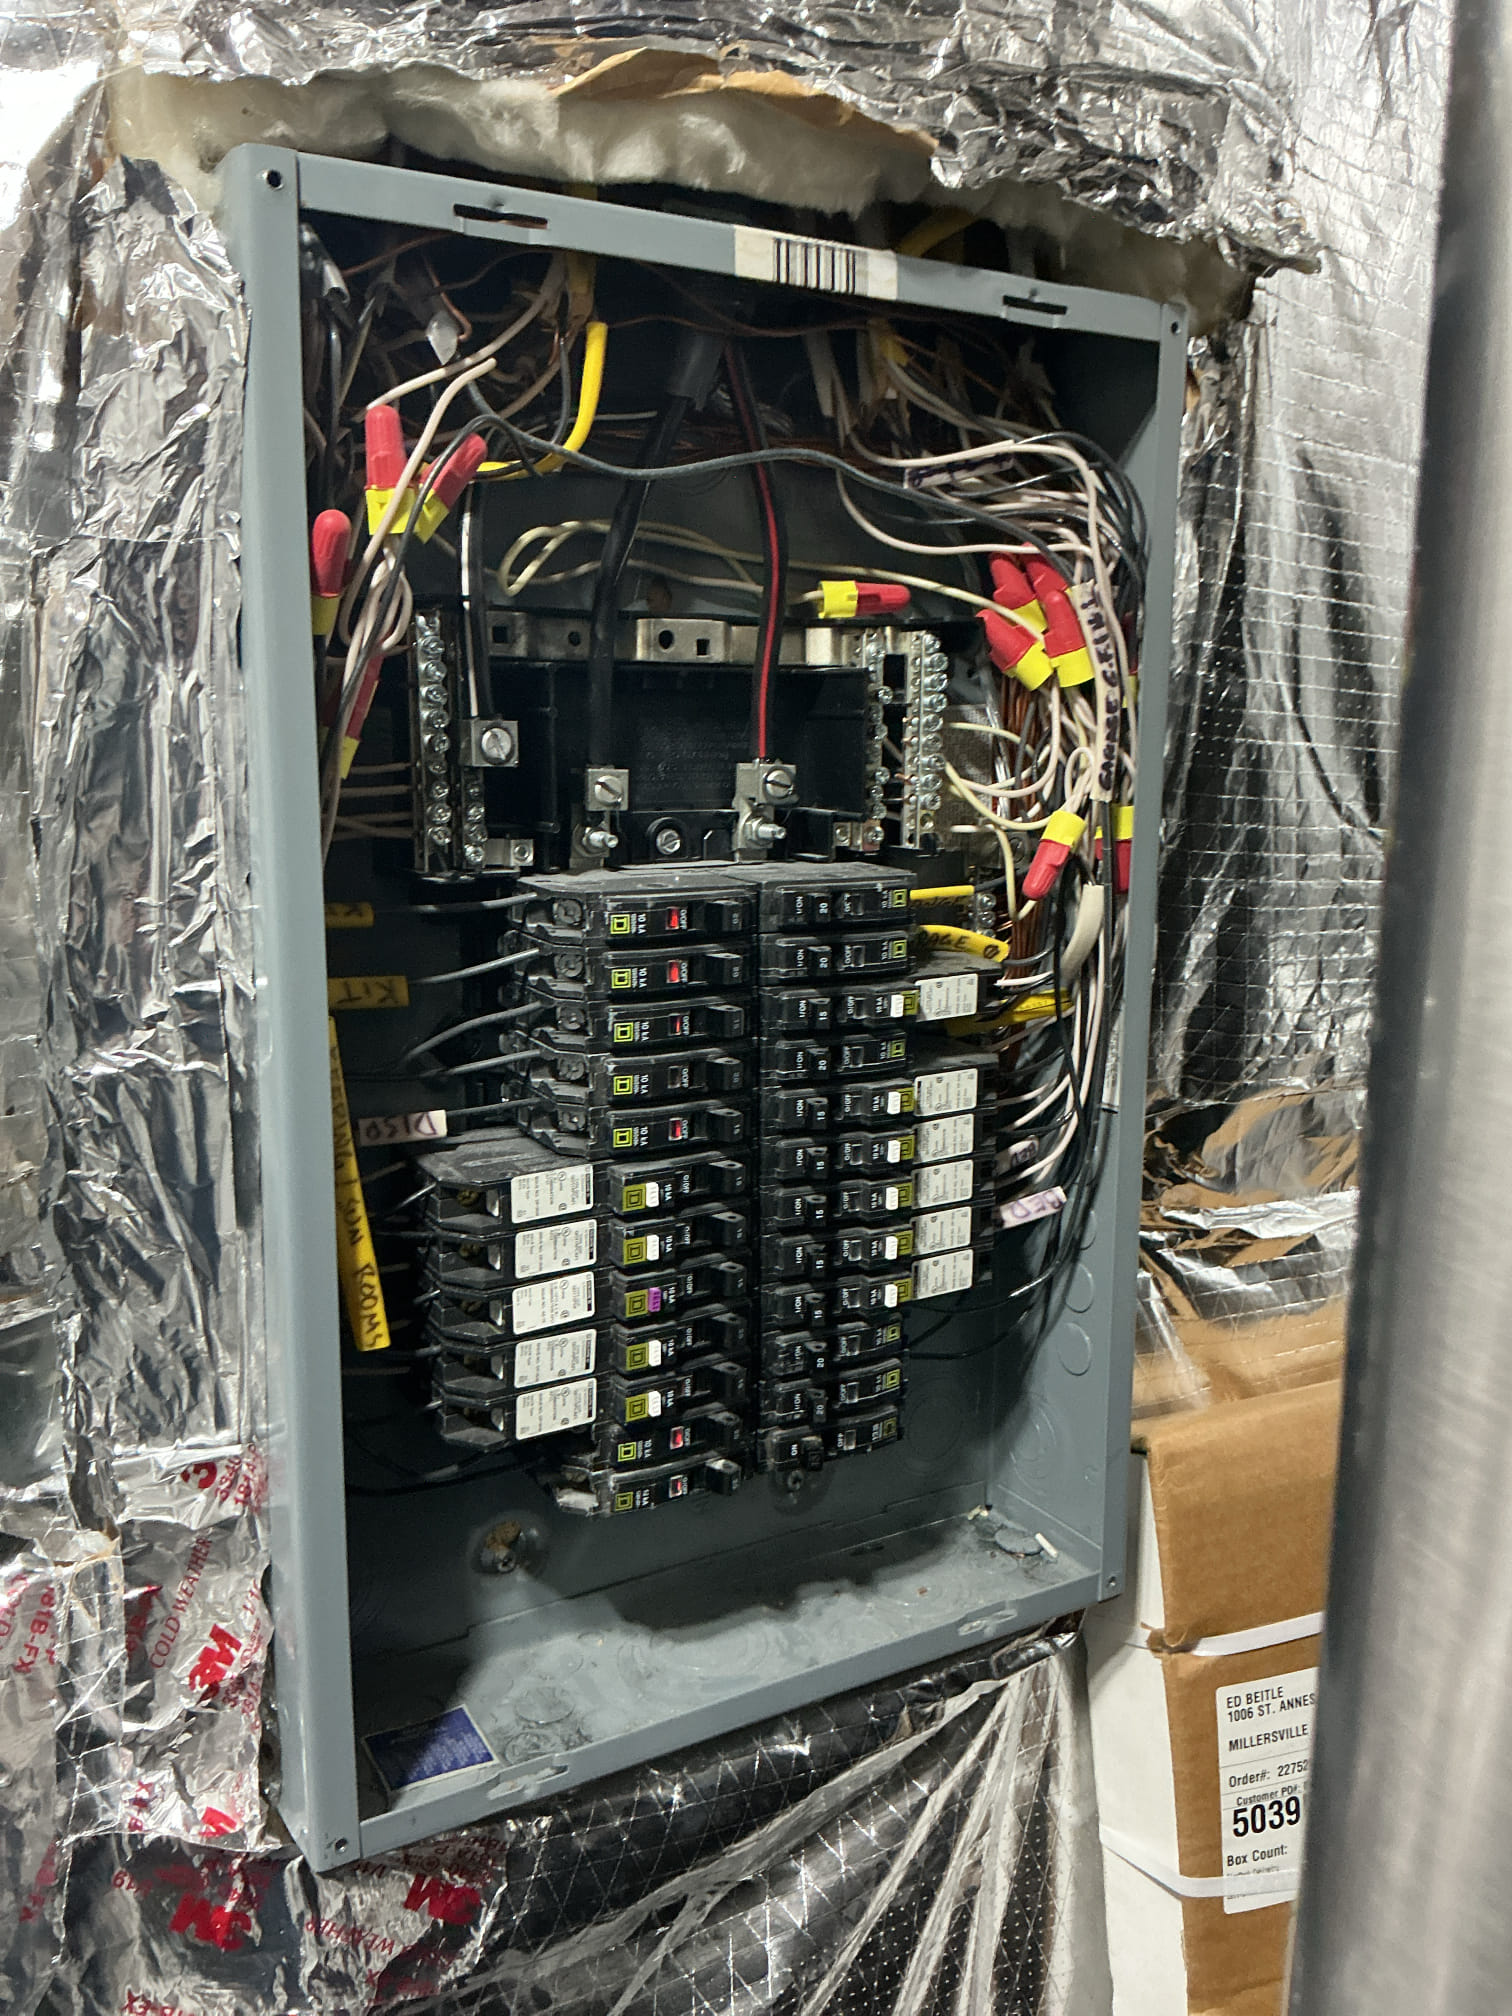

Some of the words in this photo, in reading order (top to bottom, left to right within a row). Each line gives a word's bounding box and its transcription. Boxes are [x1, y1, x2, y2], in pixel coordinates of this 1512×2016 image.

[638, 914, 646, 923] 10
[819, 958, 828, 968] 20
[639, 968, 647, 977] 10
[641, 1022, 649, 1030] 10
[819, 1060, 826, 1071] 20
[641, 1075, 648, 1083] 10
[817, 1112, 825, 1120] 15
[640, 1127, 648, 1135] 10
[816, 1210, 823, 1218] 15
[816, 1260, 823, 1269] 15
[355, 1262, 384, 1349] ROOMS
[817, 1358, 824, 1367] 20
[816, 1405, 823, 1415] 20
[150, 1616, 180, 1669] COLD
[172, 1536, 213, 1613] WEATHER
[188, 1623, 242, 1700] 3M
[1227, 1695, 1242, 1709] ED
[1246, 1686, 1284, 1705] BEITLE
[1227, 1707, 1254, 1723] 1006
[1257, 1703, 1276, 1717] ST.
[1280, 1692, 1316, 1712] ANNES
[1228, 1723, 1309, 1753] MILLERSVILLE
[1229, 1772, 1270, 1788] Order#:
[1236, 1790, 1279, 1806] Customer
[1232, 1795, 1302, 1838] 5039
[1227, 1854, 1248, 1868] Box
[1252, 1844, 1288, 1863] Count:
